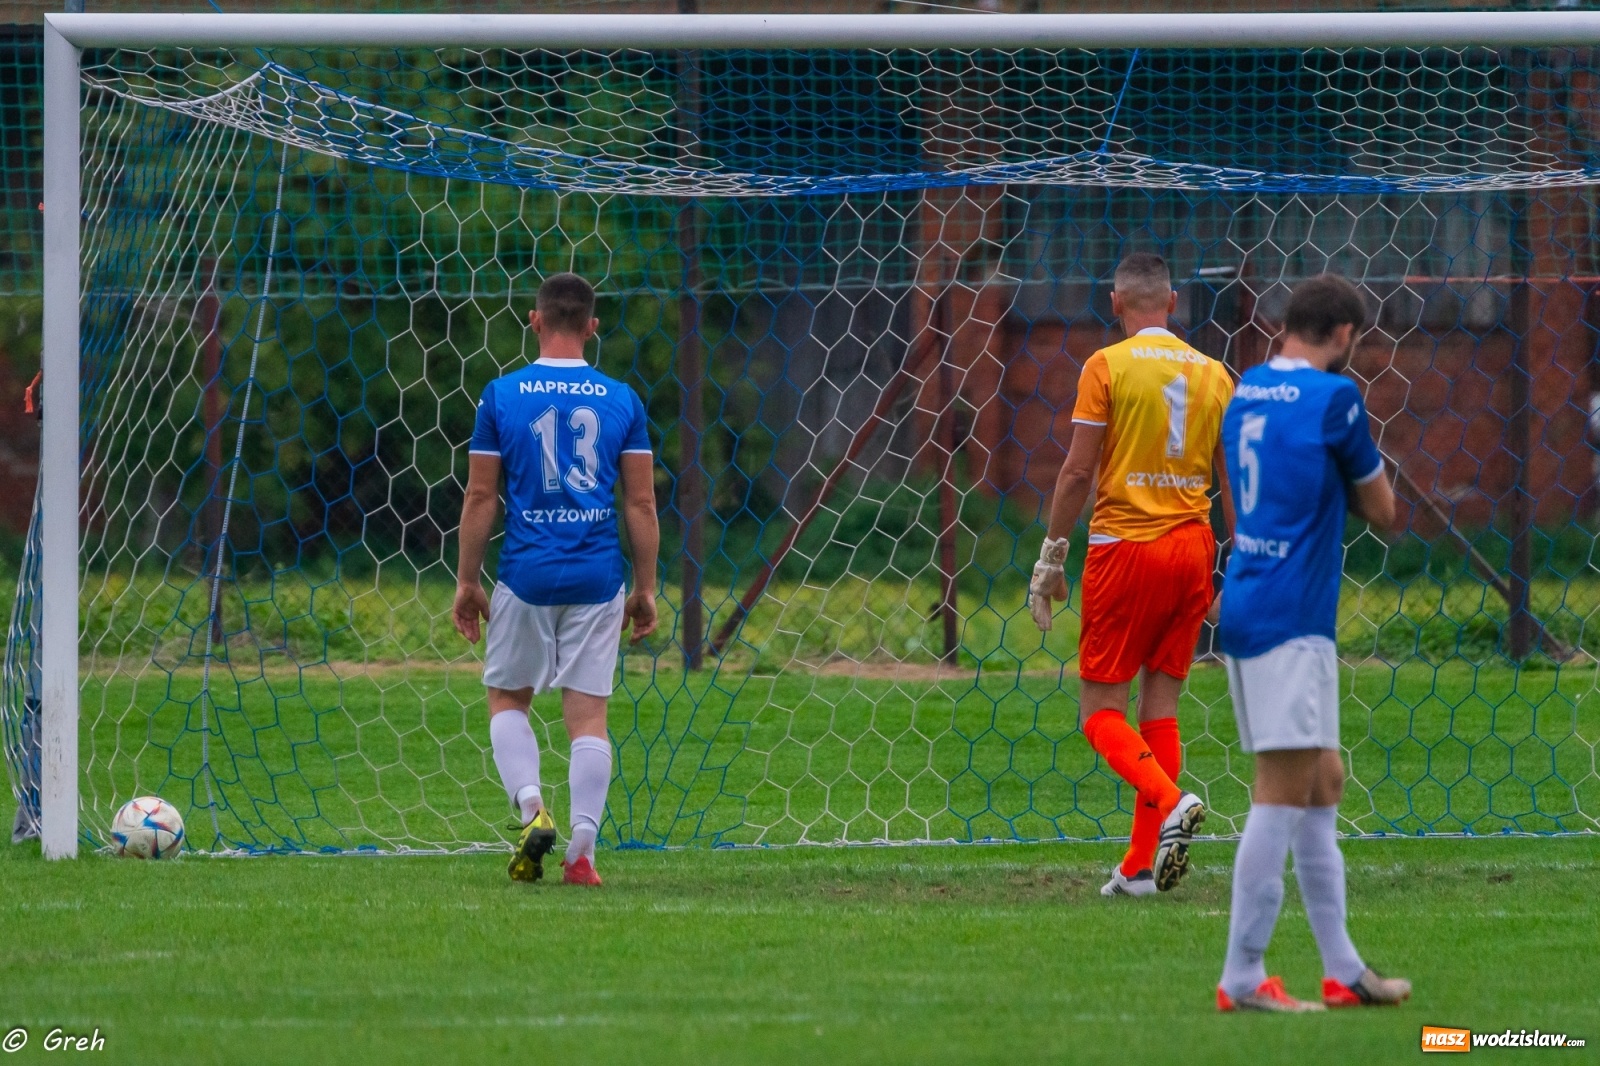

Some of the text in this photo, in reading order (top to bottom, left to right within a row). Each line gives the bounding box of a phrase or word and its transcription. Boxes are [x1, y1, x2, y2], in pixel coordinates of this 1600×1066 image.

[519, 380, 608, 396] NAPRZÓD
[1131, 347, 1207, 365] NAPRZÓD
[529, 404, 601, 493] 13
[1162, 373, 1188, 459] 1
[1238, 411, 1268, 516] 5
